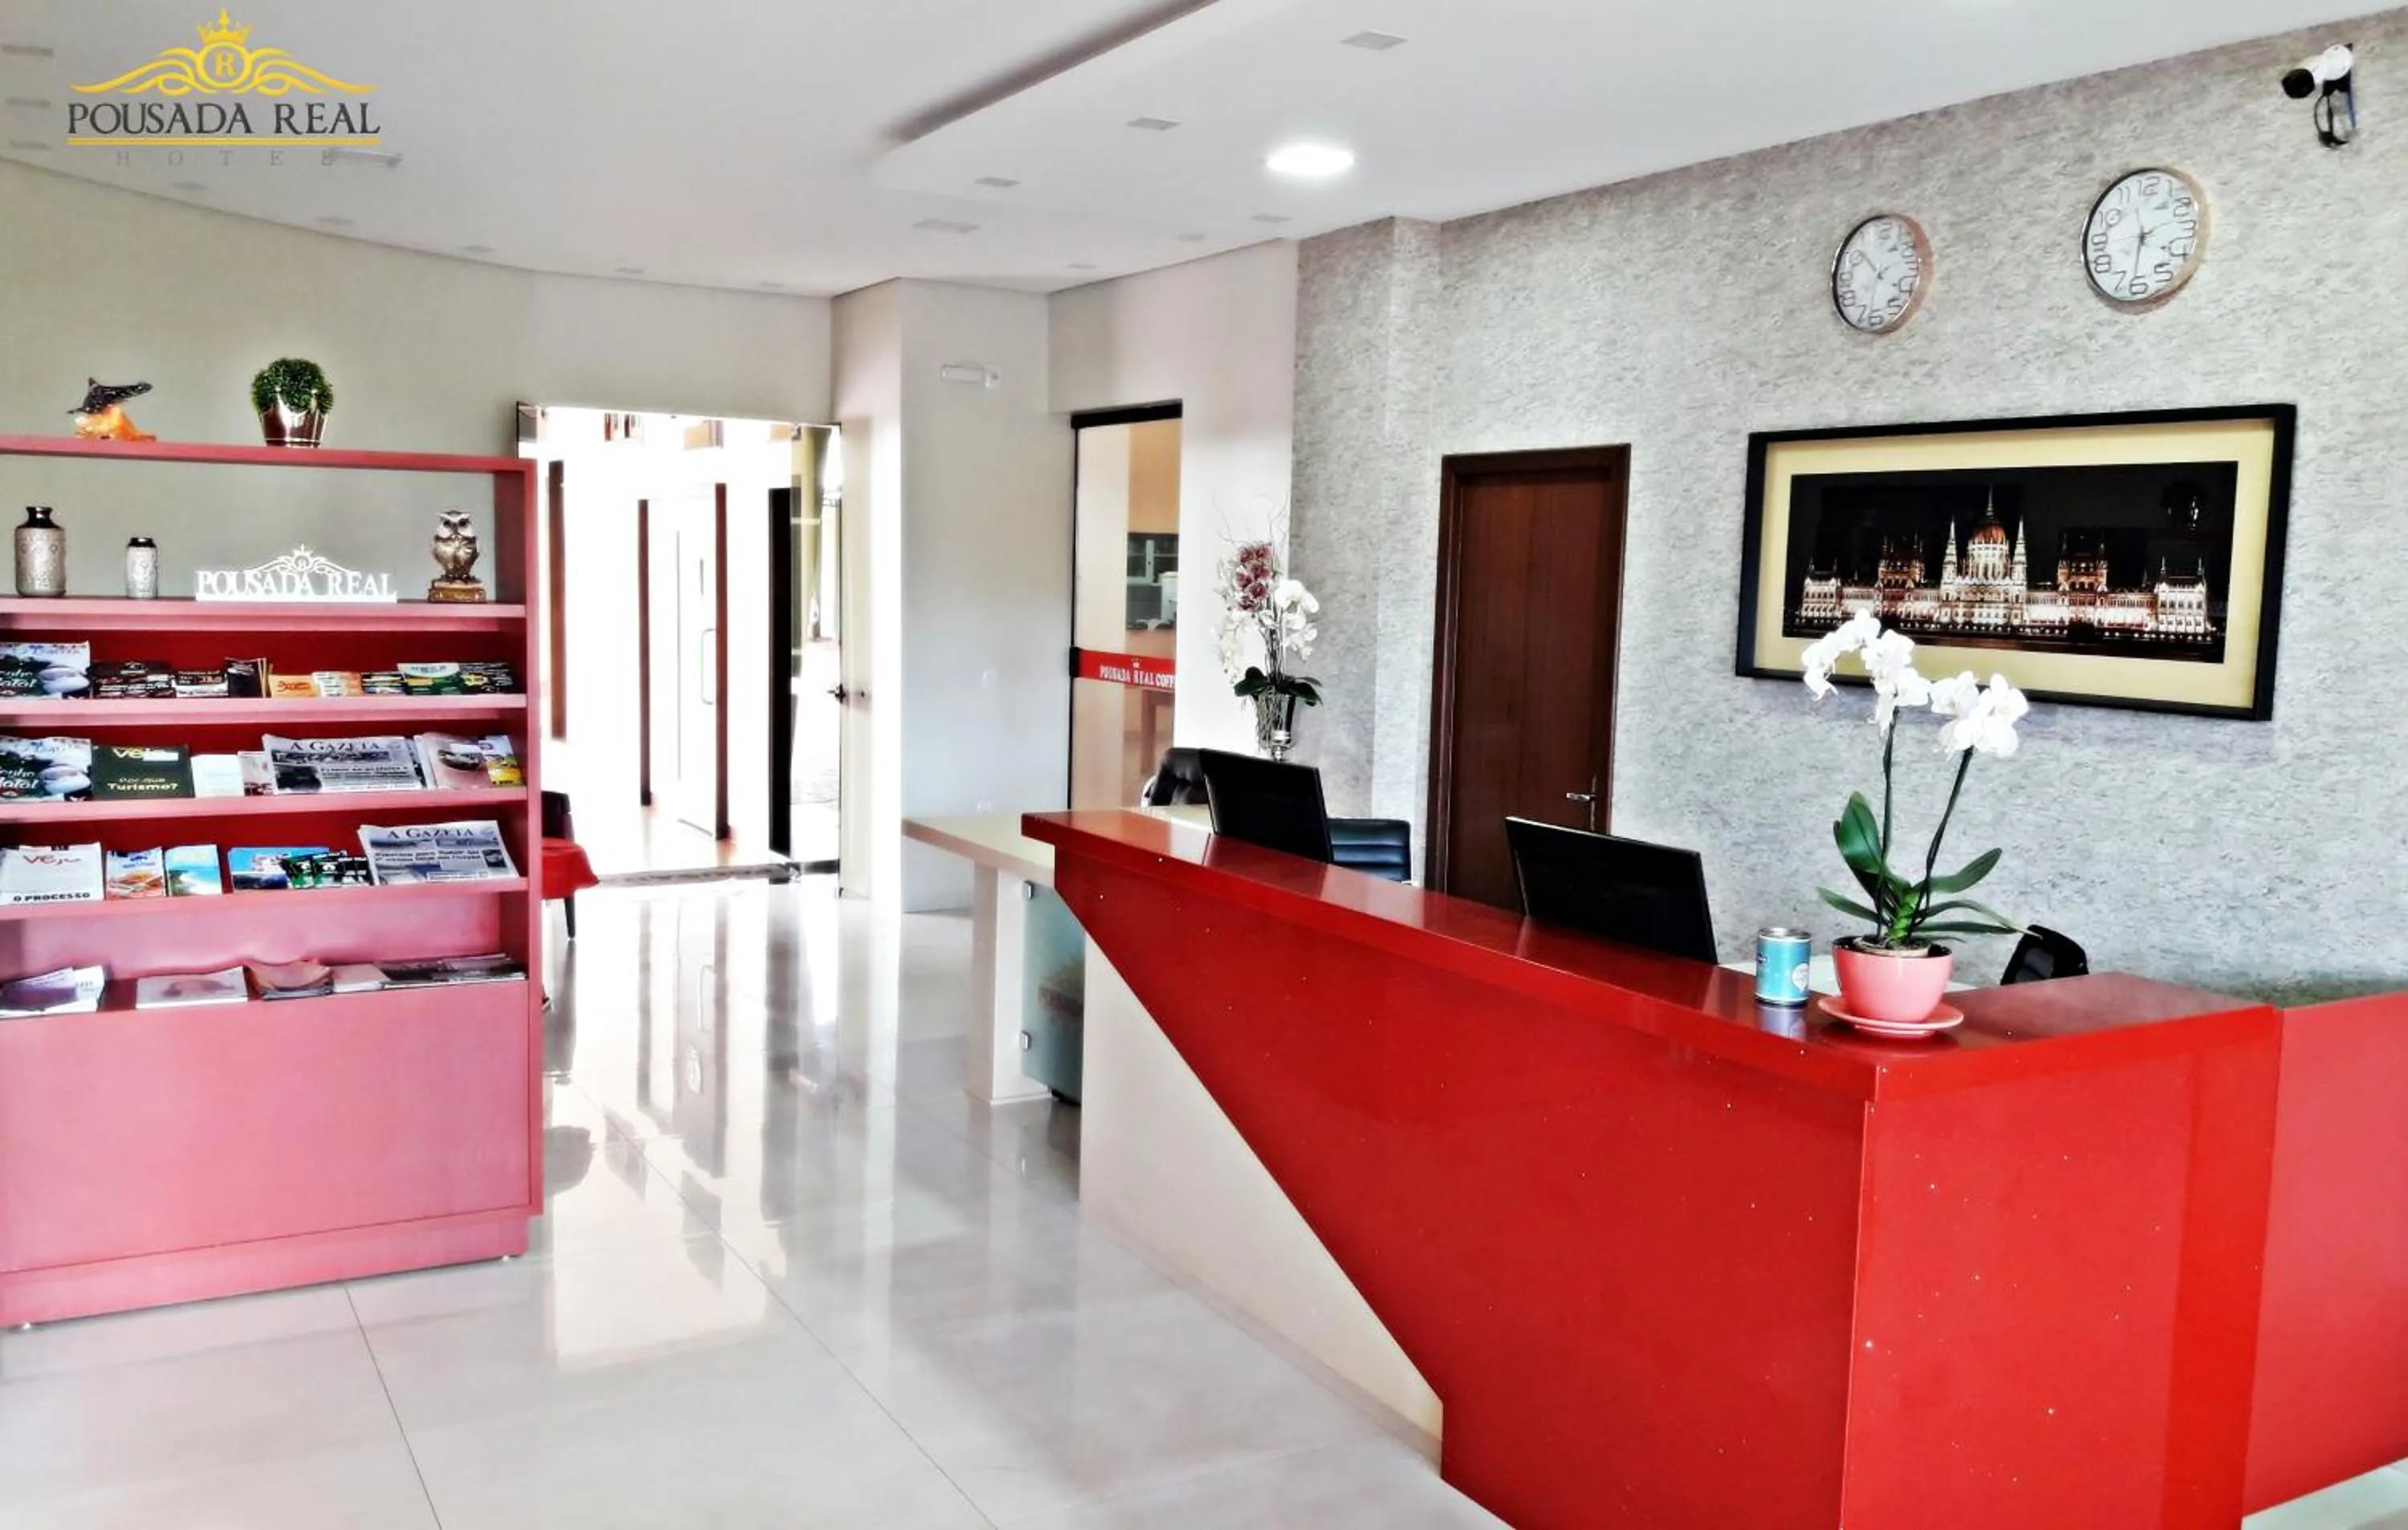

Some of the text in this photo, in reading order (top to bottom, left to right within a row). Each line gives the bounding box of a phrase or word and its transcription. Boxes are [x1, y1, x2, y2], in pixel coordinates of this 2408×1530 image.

[196, 570, 397, 597] POUSADA REAL
[1133, 668, 1154, 685] REAL
[290, 740, 380, 752] A GAZETA
[107, 783, 179, 791] Turismo?
[387, 827, 474, 840] A GAZETA
[13, 892, 91, 902] O PROCESSO
